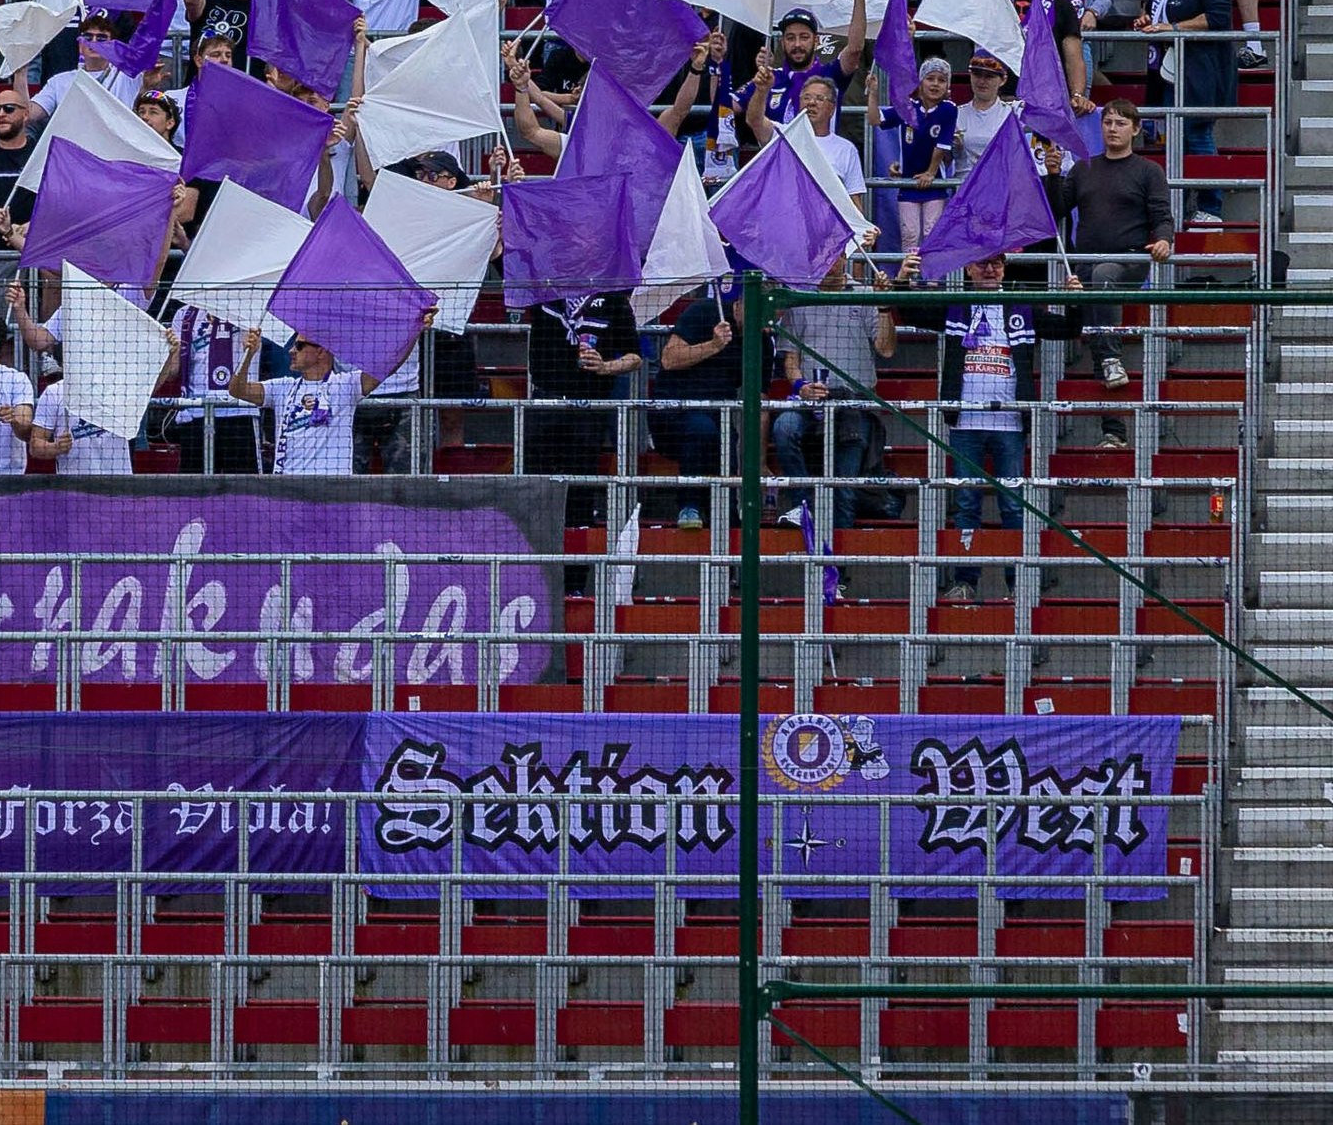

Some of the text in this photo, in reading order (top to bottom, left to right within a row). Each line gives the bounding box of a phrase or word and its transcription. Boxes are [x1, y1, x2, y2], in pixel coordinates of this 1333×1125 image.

[167, 783, 334, 835] Viola!
[375, 740, 738, 856] Sektion
[910, 736, 1151, 855] West
